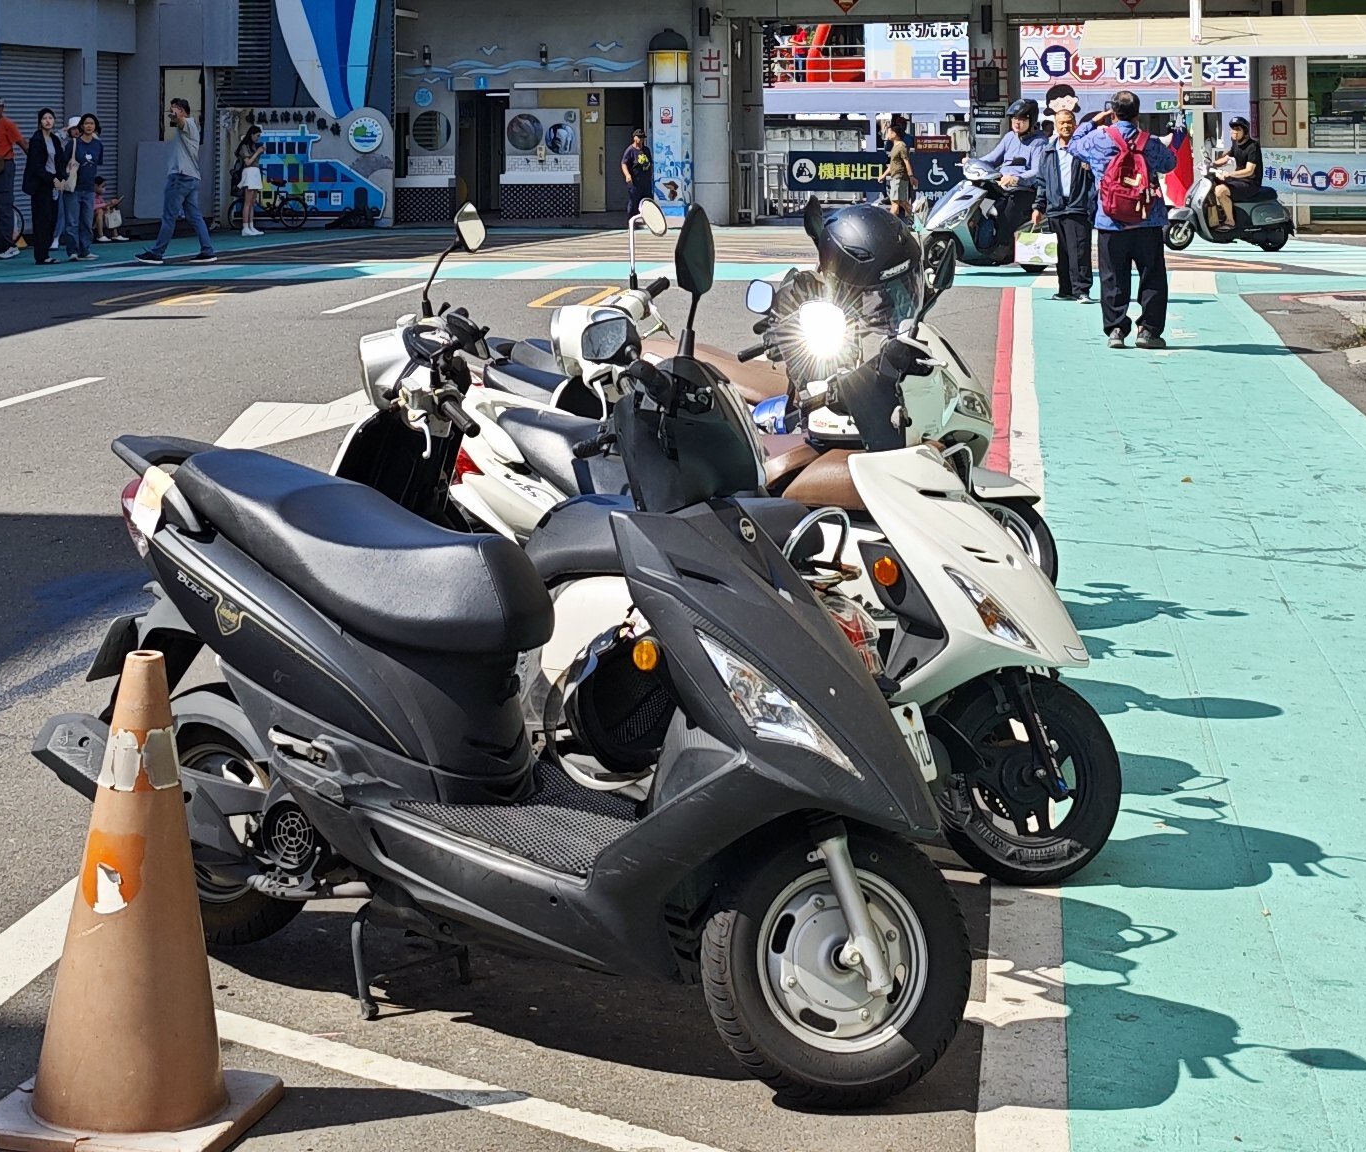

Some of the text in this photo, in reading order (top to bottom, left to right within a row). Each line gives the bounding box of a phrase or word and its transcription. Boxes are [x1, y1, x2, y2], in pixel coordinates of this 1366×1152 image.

[700, 48, 721, 98] 出口
[1046, 52, 1067, 71] 看
[1076, 58, 1098, 76] 停
[1270, 65, 1288, 136] 機車入口
[818, 163, 883, 181] 機車出口
[177, 570, 213, 601] DUKE
